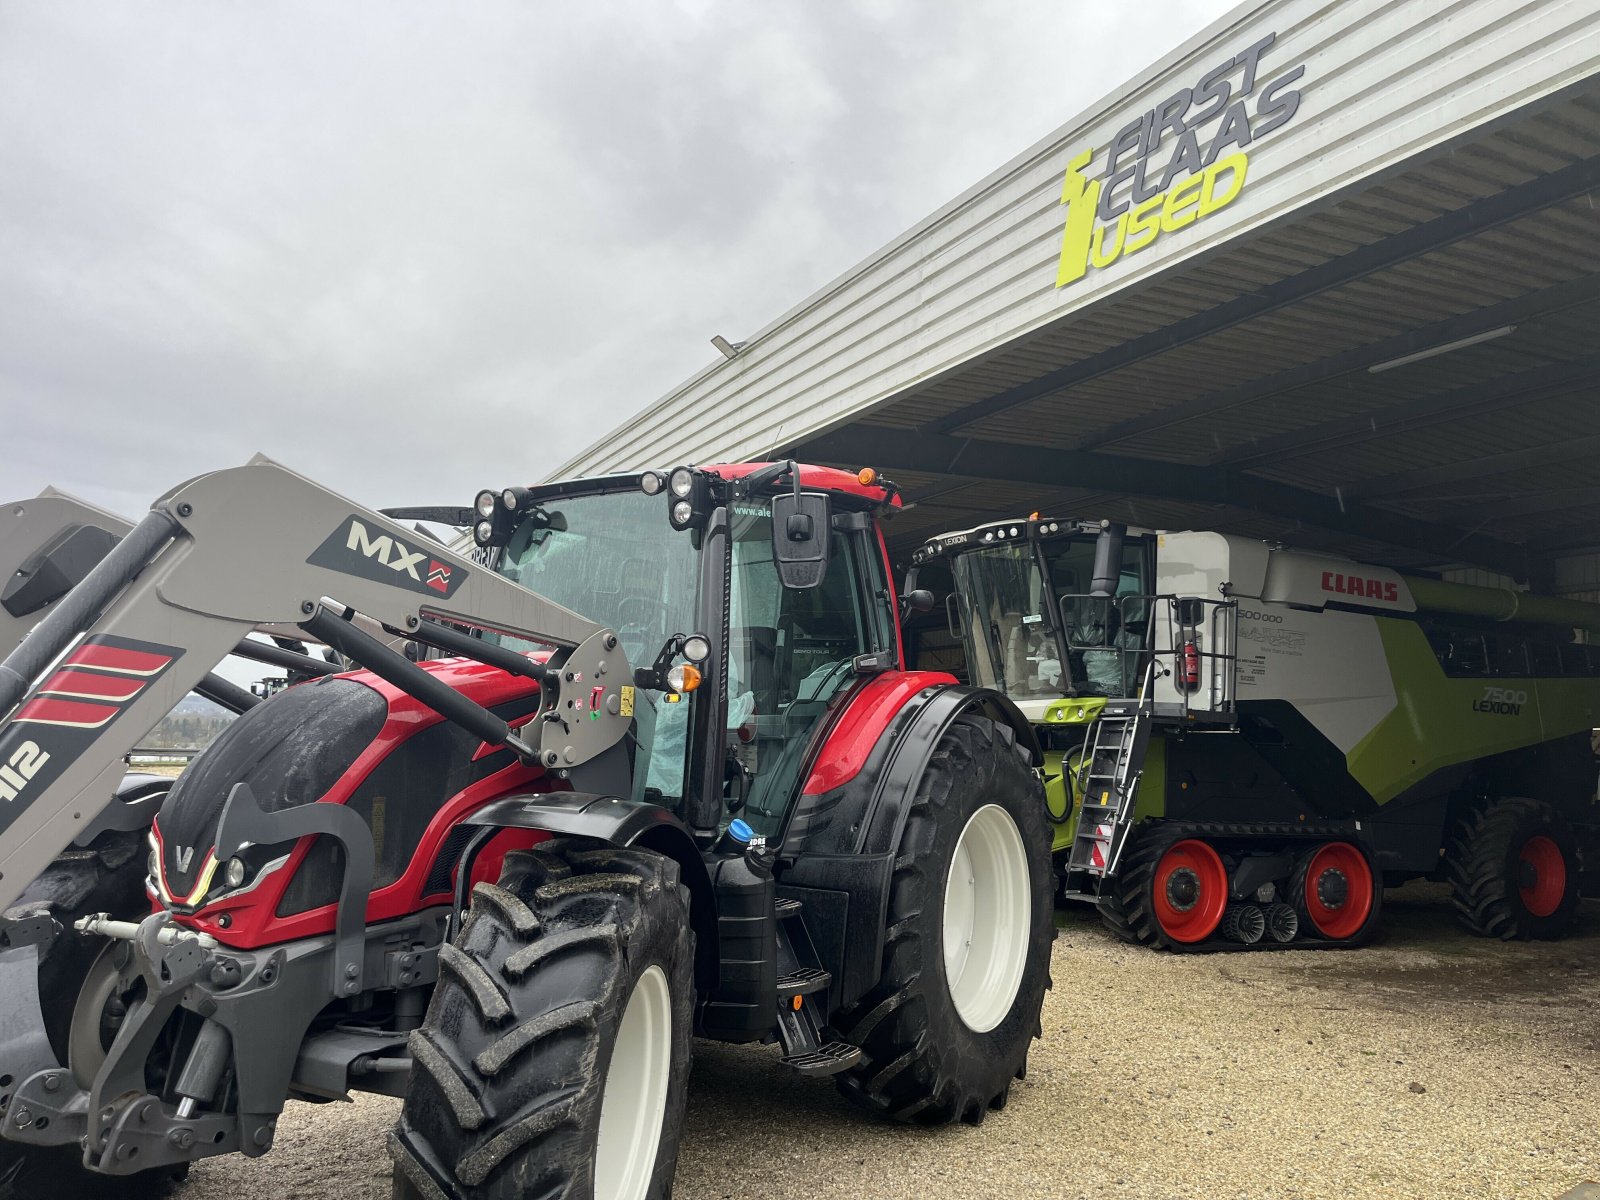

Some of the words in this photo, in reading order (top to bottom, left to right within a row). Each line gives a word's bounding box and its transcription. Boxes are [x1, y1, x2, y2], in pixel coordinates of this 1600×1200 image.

[1105, 31, 1276, 179] FIRST
[1096, 64, 1305, 221] CLAAS
[1091, 152, 1248, 269] USED
[346, 520, 428, 582] MX
[944, 535, 968, 546] LEXION
[1321, 571, 1398, 602] CLAAS
[1472, 699, 1520, 716] LEXION
